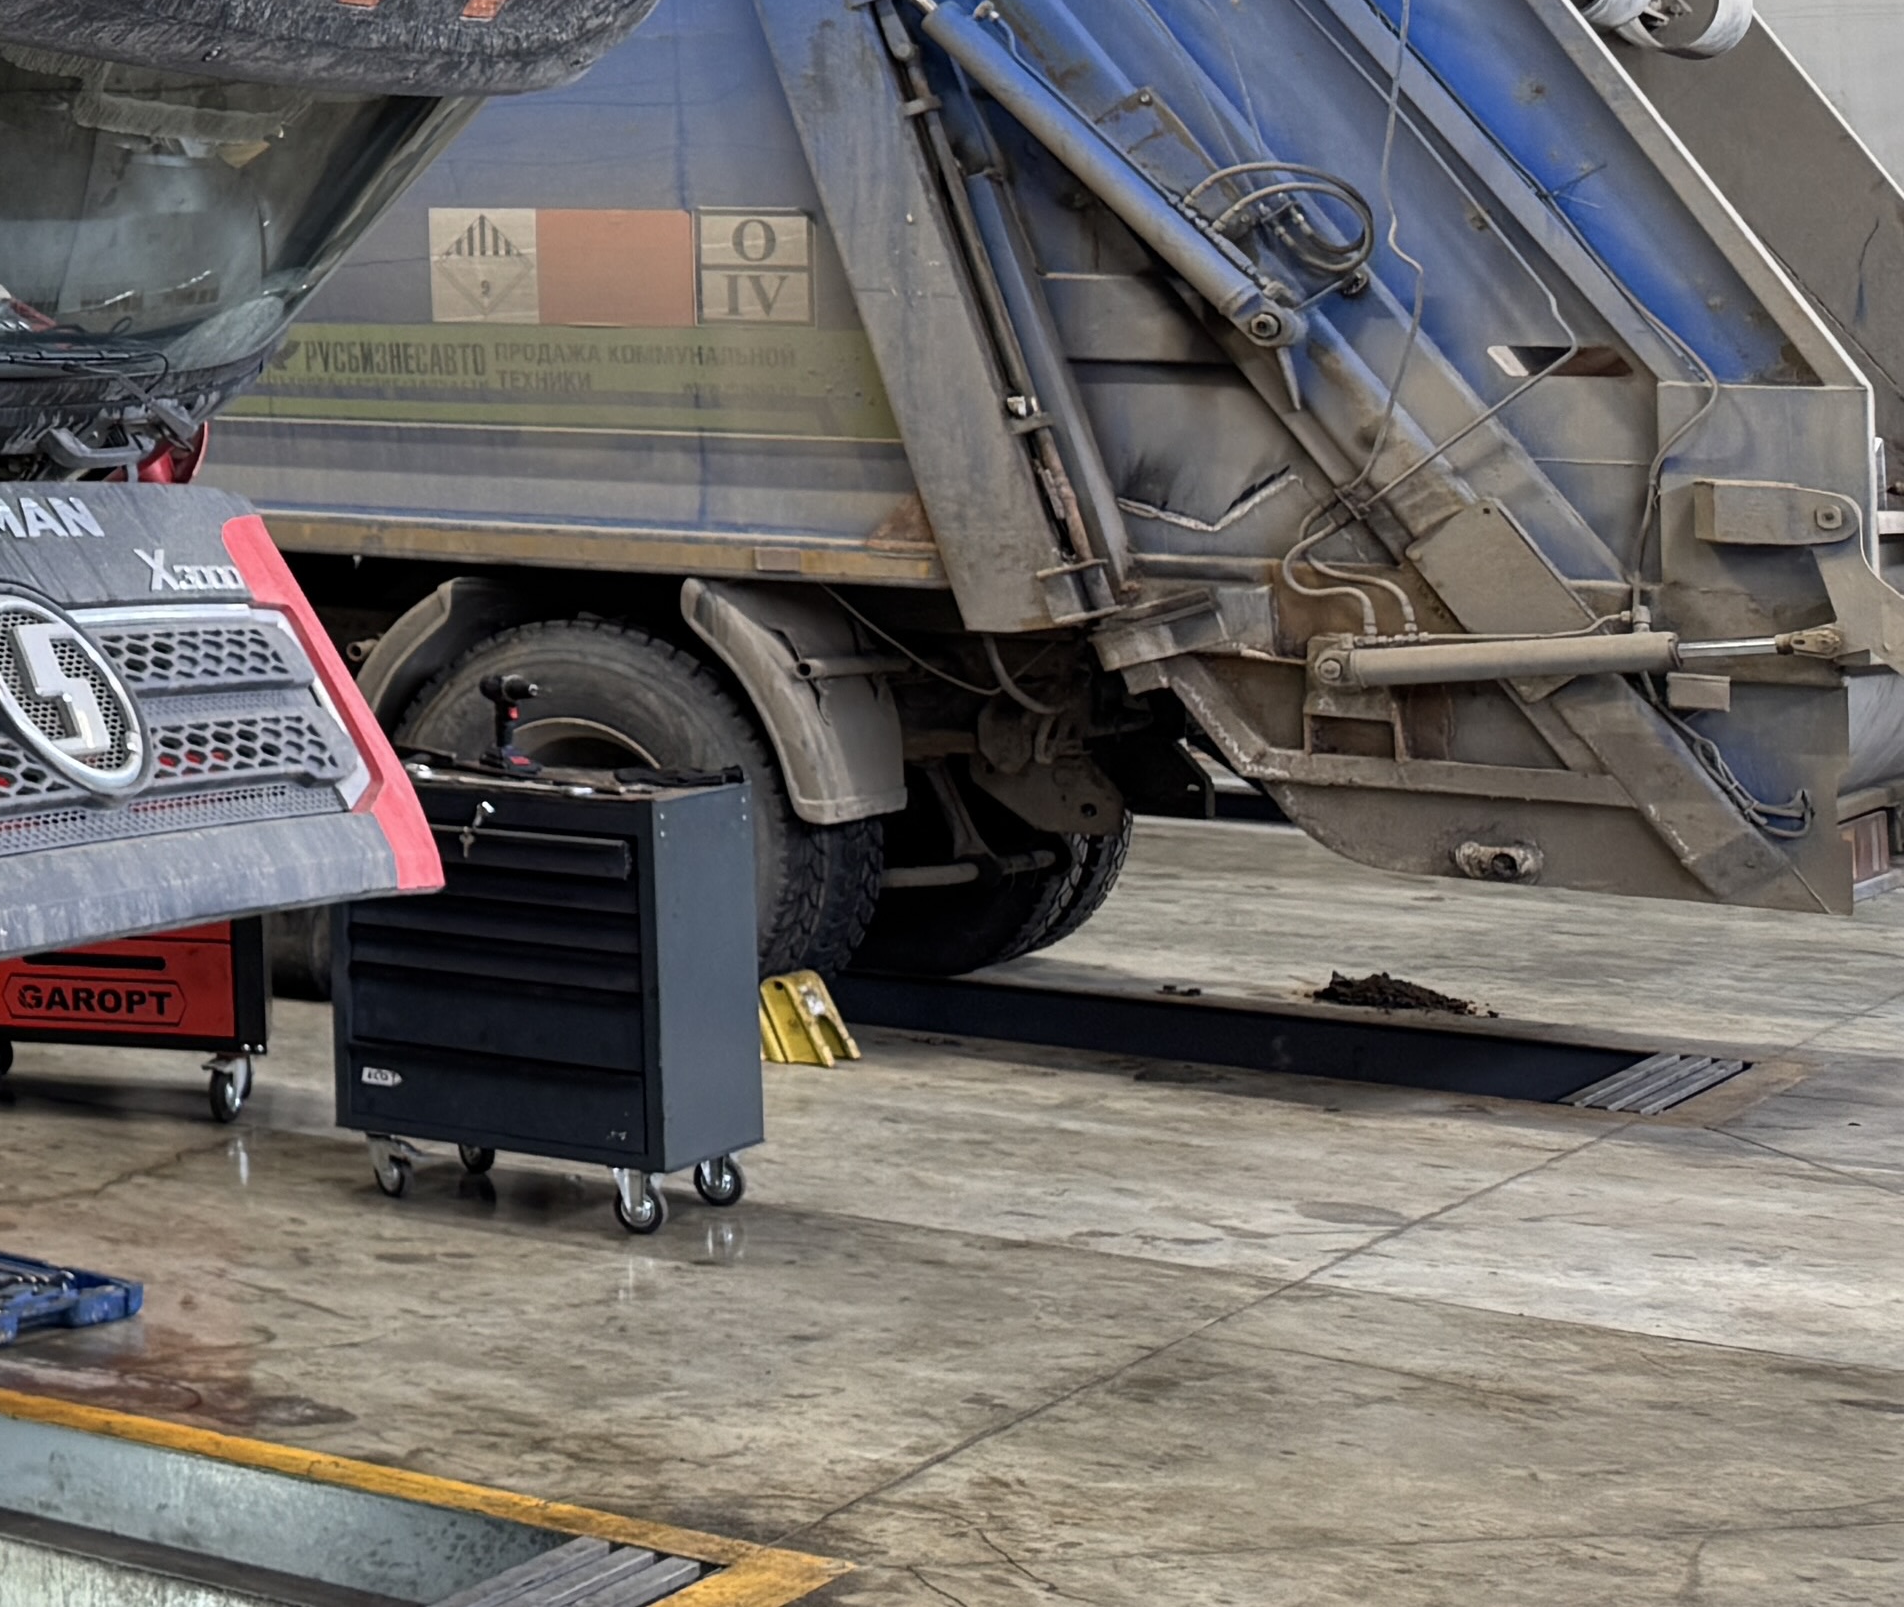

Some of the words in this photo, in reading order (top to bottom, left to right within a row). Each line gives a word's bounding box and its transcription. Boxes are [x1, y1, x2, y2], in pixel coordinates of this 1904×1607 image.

[723, 274, 787, 317] IV
[304, 340, 487, 376] РУСБИЗНЕСАВТО
[494, 341, 601, 366] ПРОДАЖА
[607, 343, 796, 368] КОММУНАЛЬНОЙ
[495, 368, 592, 392] ТЕХНИКИ
[18, 984, 172, 1016] GAROPT
